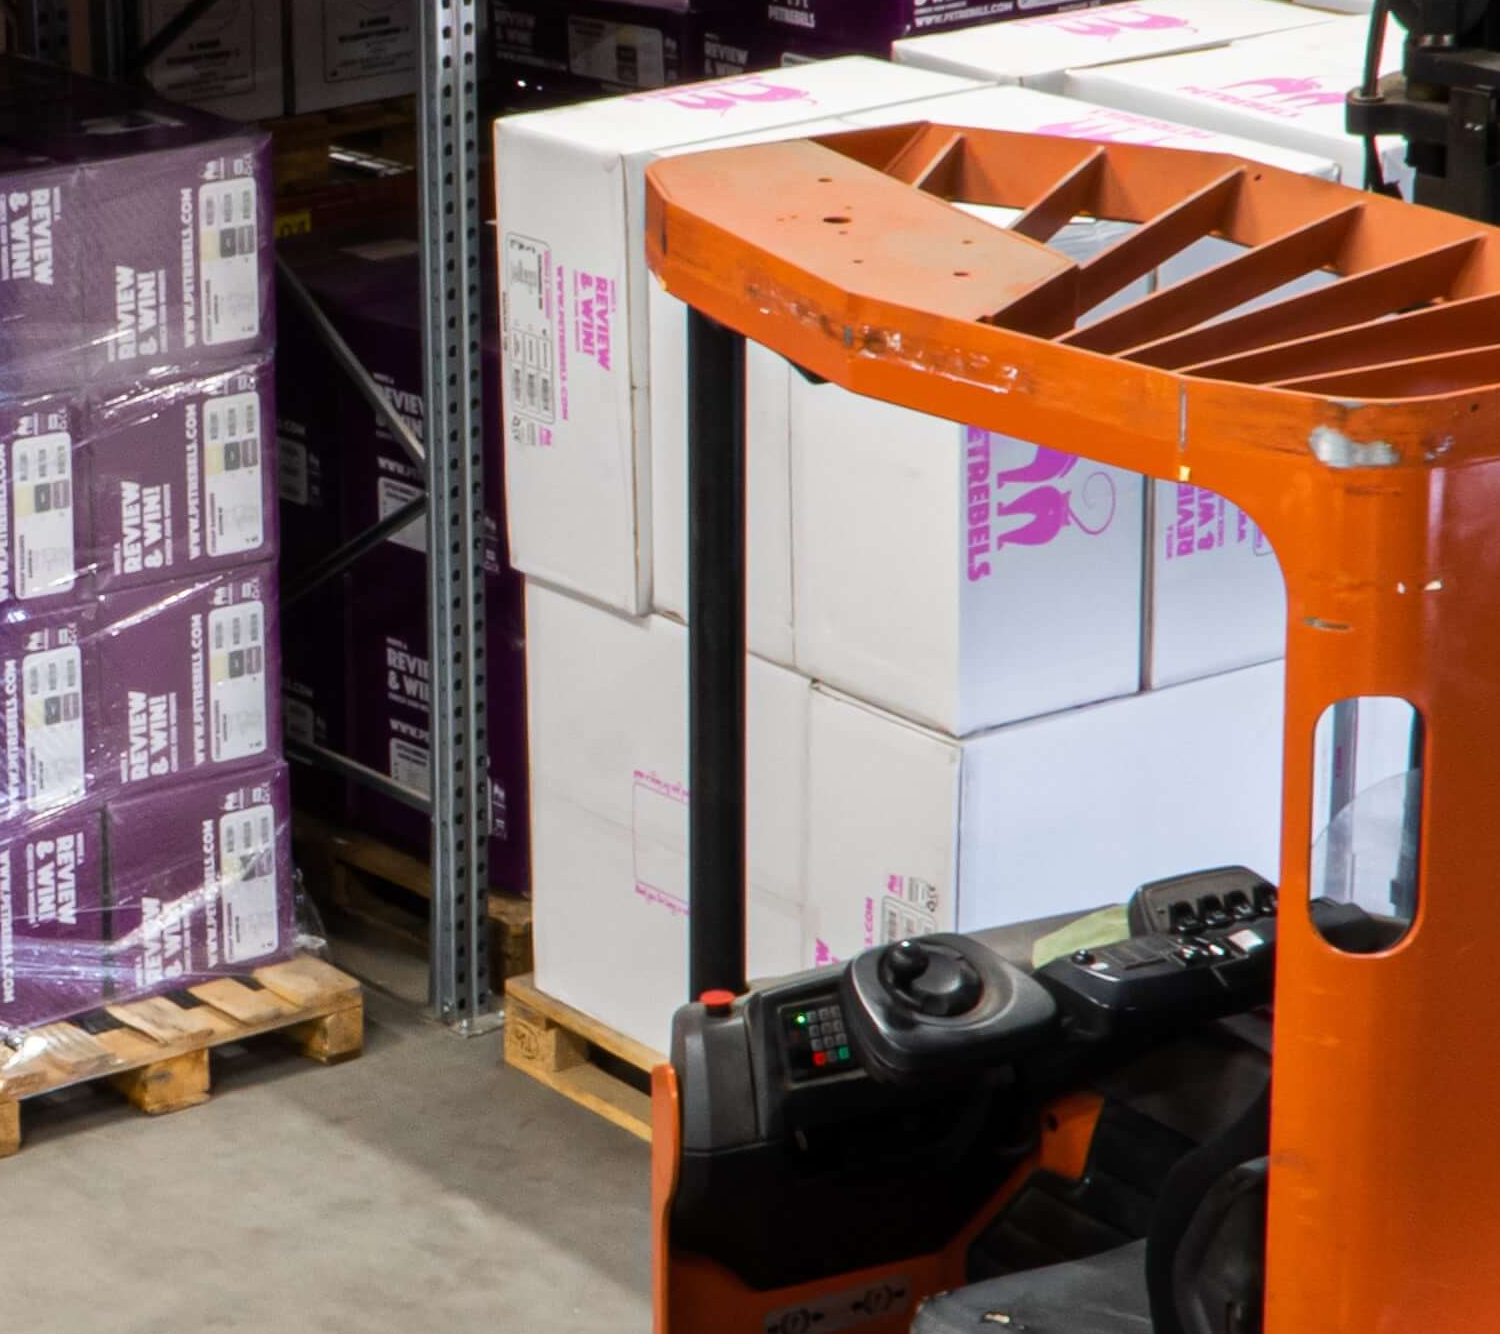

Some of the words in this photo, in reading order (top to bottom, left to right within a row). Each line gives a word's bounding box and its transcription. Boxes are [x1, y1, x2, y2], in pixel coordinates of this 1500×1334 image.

[768, 5, 816, 28] PETREBELS
[11, 216, 31, 278] WIN!
[31, 189, 53, 285] REVIEW
[582, 299, 597, 354] WIN!
[589, 276, 611, 369] REVIEW
[967, 424, 991, 581] ETREBELS
